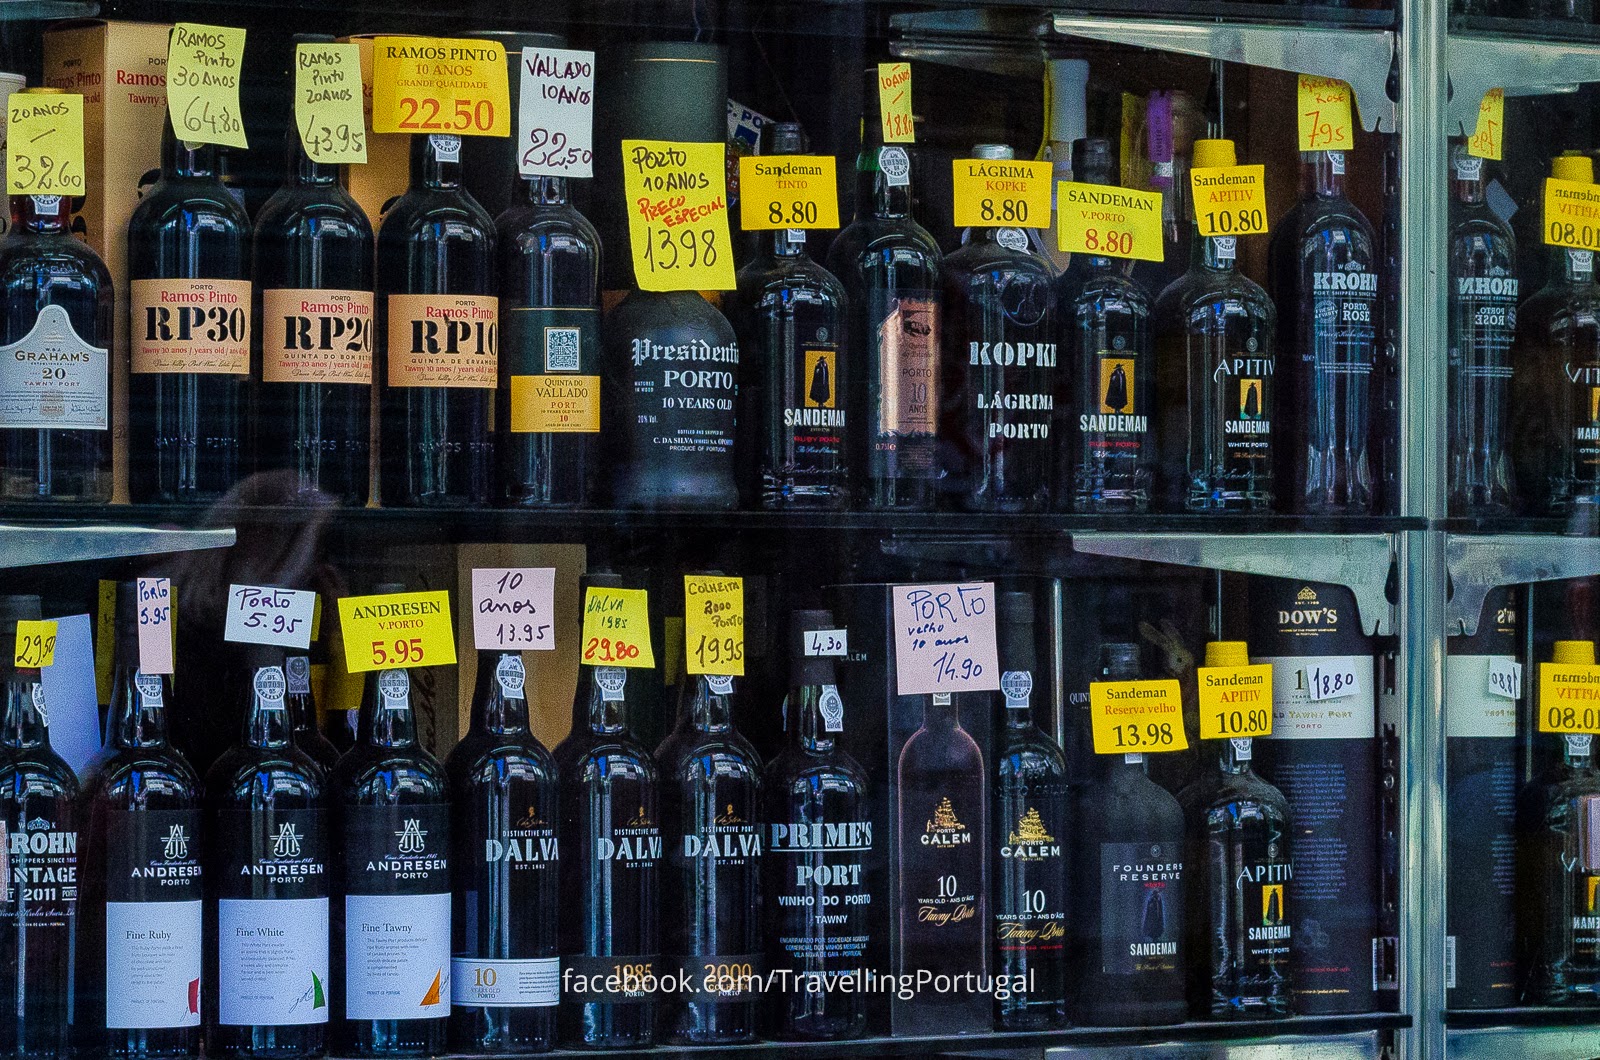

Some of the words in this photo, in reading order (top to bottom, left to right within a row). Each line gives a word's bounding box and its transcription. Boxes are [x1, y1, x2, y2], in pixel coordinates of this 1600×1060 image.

[177, 27, 226, 49] RAMOS
[300, 52, 342, 69] RAMOS
[387, 46, 446, 60] RAMOS
[450, 48, 497, 62] PINTO
[415, 64, 429, 75] 10
[432, 65, 473, 77] ANOS
[526, 53, 592, 79] VALLADO
[117, 70, 166, 87] Ramos
[173, 66, 199, 86] 30
[397, 80, 434, 88] GRANDE
[436, 80, 488, 89] QUALIDADE
[128, 93, 158, 106] Tawny
[184, 96, 240, 134] 64.80
[399, 97, 495, 131] 22.50
[305, 114, 363, 156] 43.95
[14, 155, 81, 189] 32.60
[755, 162, 822, 176] Sandeman
[969, 163, 1034, 179] LÁGRIMA
[776, 180, 808, 189] TINTO
[986, 181, 1027, 192] KOPKE
[1194, 173, 1256, 187] Sandeman
[1068, 190, 1153, 212] SANDEMAN
[1209, 189, 1254, 203] APITIV
[662, 196, 725, 228] ESPECIAL
[768, 201, 817, 224] 8.80
[981, 199, 1028, 222] 8.80
[1081, 211, 1125, 223] V.PORTO
[1205, 209, 1263, 234] 10.80
[644, 226, 717, 272] 13.98
[1085, 228, 1133, 254] 8.80
[1313, 272, 1377, 291] KROHN
[161, 291, 205, 303] Ramos
[209, 291, 238, 303] Pinto
[301, 301, 343, 313] Ramos
[348, 302, 369, 314] Pinto
[426, 306, 468, 318] Ramos
[472, 307, 493, 319] Pinto
[1343, 302, 1367, 311] PORTO
[145, 306, 246, 343] RP30
[284, 316, 372, 352] RP20
[410, 320, 497, 356] RP10
[15, 351, 90, 362] GRAHAM'S
[194, 347, 213, 355] years
[214, 346, 224, 354] old
[42, 367, 66, 380] 20
[333, 361, 350, 370] years
[458, 365, 475, 374] years
[902, 369, 932, 378] PORTO
[1214, 355, 1275, 382] APITIV
[544, 378, 573, 388] QUINTA
[664, 370, 733, 390] PORTO
[536, 388, 588, 398] VALLADO
[912, 384, 927, 404] 10
[977, 390, 1053, 410] LÁGRIMA
[662, 398, 675, 408] 10
[678, 398, 715, 409] YEARS
[717, 399, 733, 410] OLD
[784, 408, 846, 427] SANDEMAN
[1080, 414, 1147, 433] SANDEMAN
[989, 422, 1048, 439] PORTO
[1225, 420, 1270, 434] SANDEMAN
[497, 571, 523, 594] 10
[352, 600, 441, 620] ANDRESEN
[479, 598, 536, 615] anos
[140, 607, 170, 625] 5.95
[243, 612, 303, 634] 5.95
[1278, 608, 1338, 624] DOW'S
[378, 619, 424, 631] V.PORTO
[496, 623, 551, 645] 13.95
[371, 638, 424, 665] 5.95
[584, 637, 640, 662] 29.80
[696, 635, 744, 668] 19.95
[812, 633, 843, 653] 4.30
[933, 652, 983, 683] 14.90
[1206, 673, 1264, 687] Sandeman
[1313, 667, 1354, 698] 18.80
[1106, 688, 1168, 701] Sandeman
[1220, 690, 1262, 703] APITIV
[1104, 705, 1146, 715] Reserva
[1147, 703, 1177, 715] velho
[1216, 709, 1268, 734] 10.80
[1113, 722, 1174, 747] 13.98
[614, 828, 649, 836] DISTINCTIVE
[701, 826, 739, 834] DISTINCTIVE
[770, 822, 872, 848] PRIME'S
[485, 837, 559, 862] DALVA
[597, 836, 662, 860] DALVA
[684, 834, 762, 857] DALVA
[241, 864, 324, 876] ANDRESEN
[366, 860, 447, 871] ANDRESEN
[1113, 863, 1183, 872] FOUNDERS
[796, 865, 862, 887] PORT
[1120, 873, 1180, 881] RESERVE
[23, 888, 56, 901] 2011
[937, 875, 957, 897] 10
[778, 896, 814, 906] VINHO
[822, 896, 839, 906] DO
[845, 894, 871, 905] PORTO
[1022, 890, 1046, 913] 10
[815, 915, 848, 924] TAWNY
[918, 906, 951, 927] Tawny
[126, 930, 146, 940] Fine
[149, 930, 172, 941] Ruby
[236, 928, 254, 937] Fine
[257, 928, 285, 937] White
[362, 923, 380, 933] Fine
[383, 923, 413, 935] Tawny
[997, 922, 1039, 944] Tawny
[1249, 925, 1291, 940] SANDEMAN
[1130, 942, 1177, 956] SANDEMAN
[473, 968, 497, 987] 10
